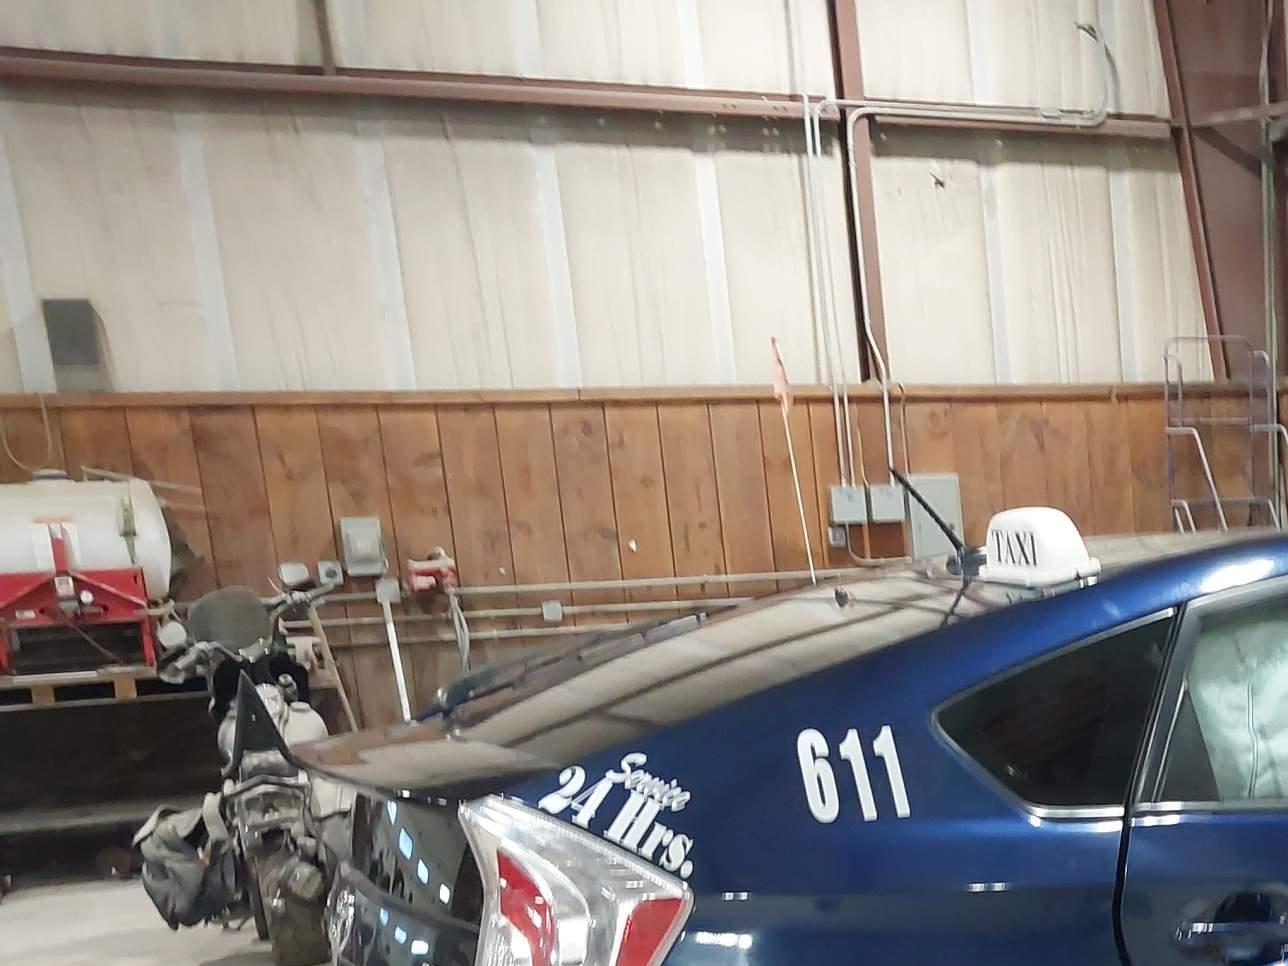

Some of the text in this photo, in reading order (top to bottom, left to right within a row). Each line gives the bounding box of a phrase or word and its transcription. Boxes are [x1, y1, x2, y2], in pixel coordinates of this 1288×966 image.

[991, 529, 1037, 567] TAXI
[538, 765, 694, 880] 24 Hrs.
[797, 725, 911, 824] 611
